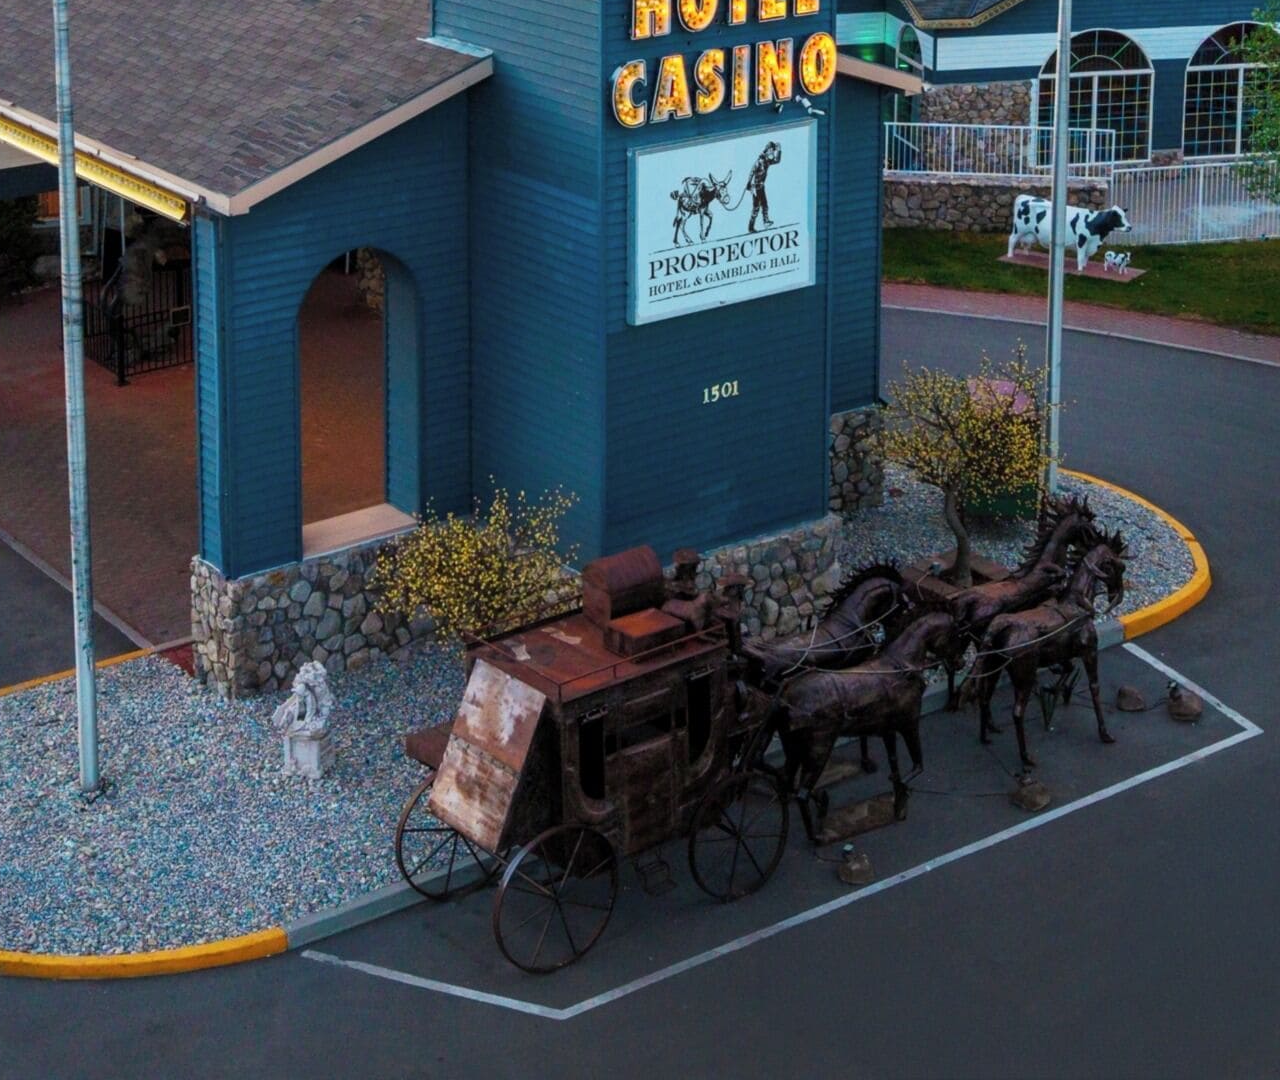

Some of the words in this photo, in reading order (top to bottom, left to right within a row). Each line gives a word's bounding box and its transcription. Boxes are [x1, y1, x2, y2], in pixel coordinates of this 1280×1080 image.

[611, 31, 838, 129] CASINO
[648, 229, 799, 280] PROSPECTOR
[649, 278, 691, 297] HOTEL
[693, 276, 703, 286] &
[704, 261, 767, 284] GAMBLING
[770, 253, 800, 269] HALL
[702, 379, 740, 405] 1501
